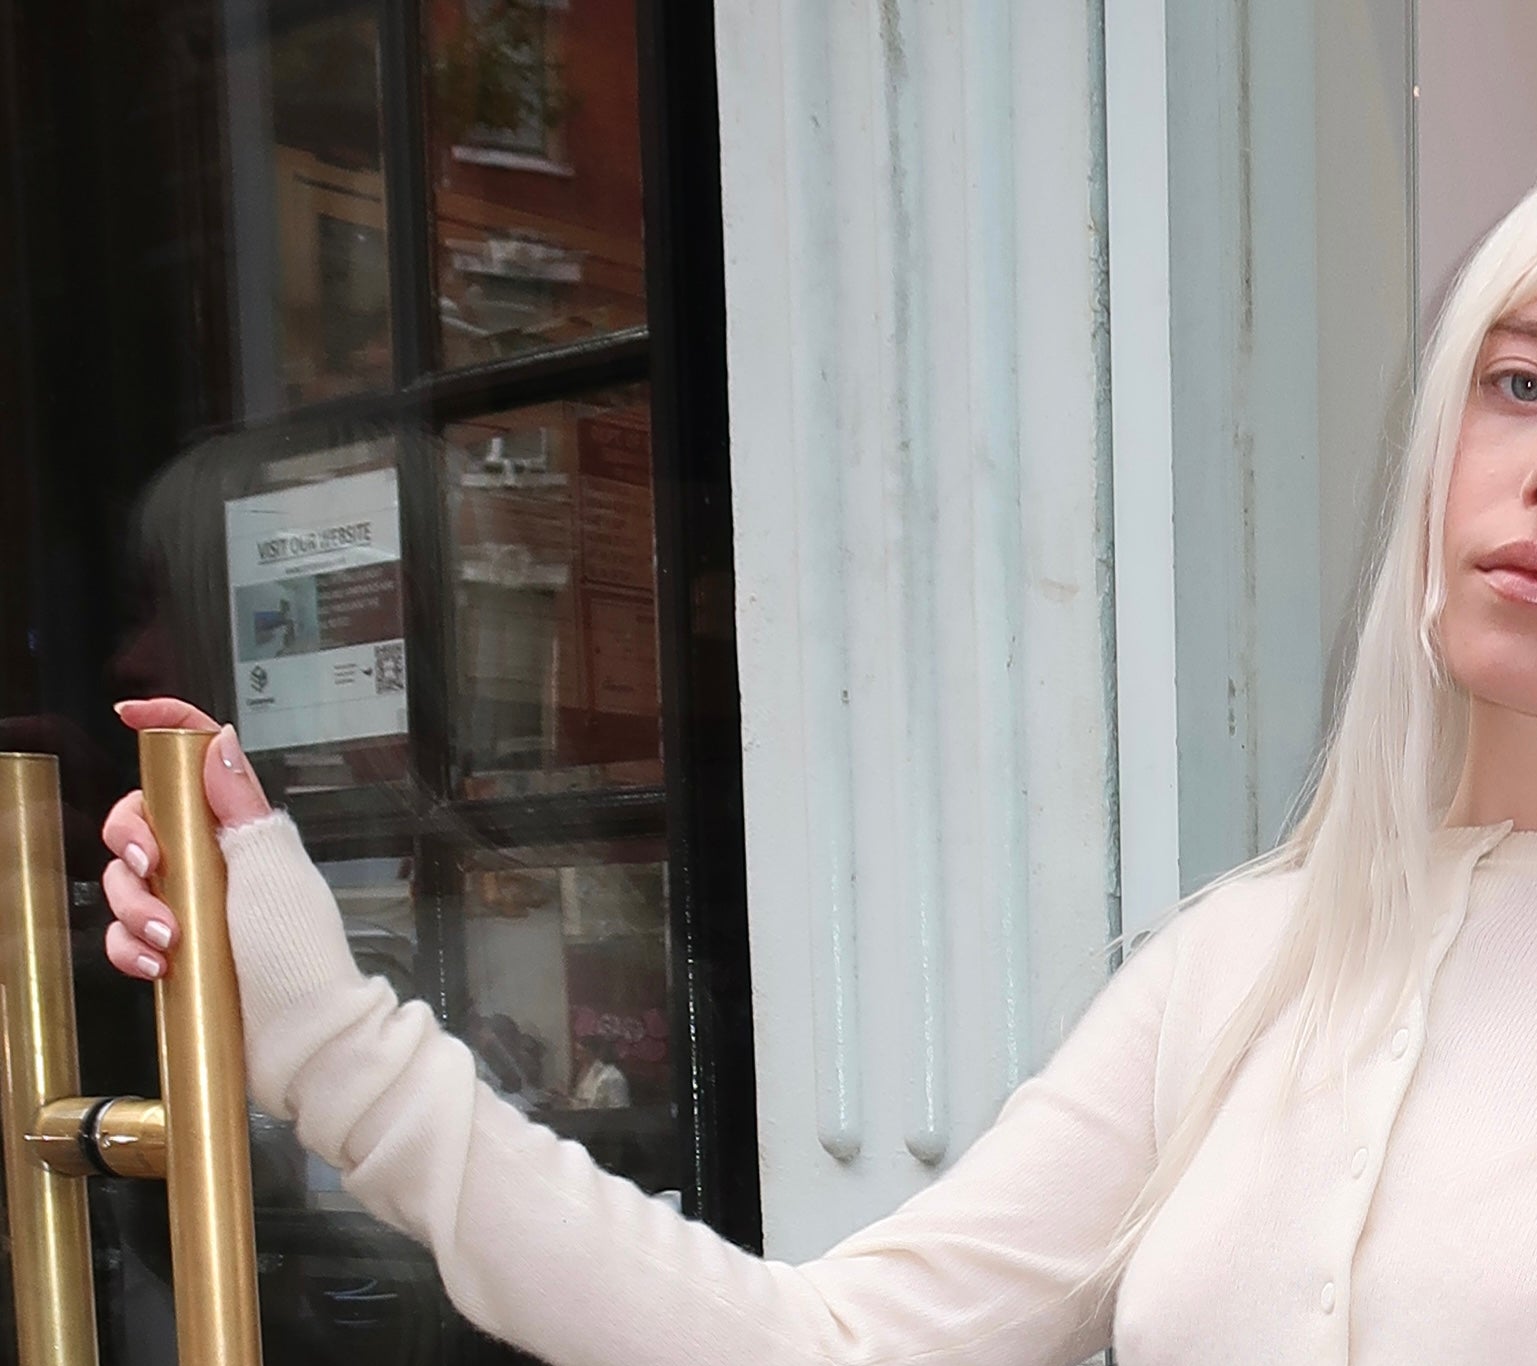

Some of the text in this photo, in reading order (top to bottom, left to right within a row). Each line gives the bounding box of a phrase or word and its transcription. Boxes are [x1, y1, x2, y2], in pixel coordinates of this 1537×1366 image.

[257, 522, 372, 559] VISIT OUR WEBSITE
